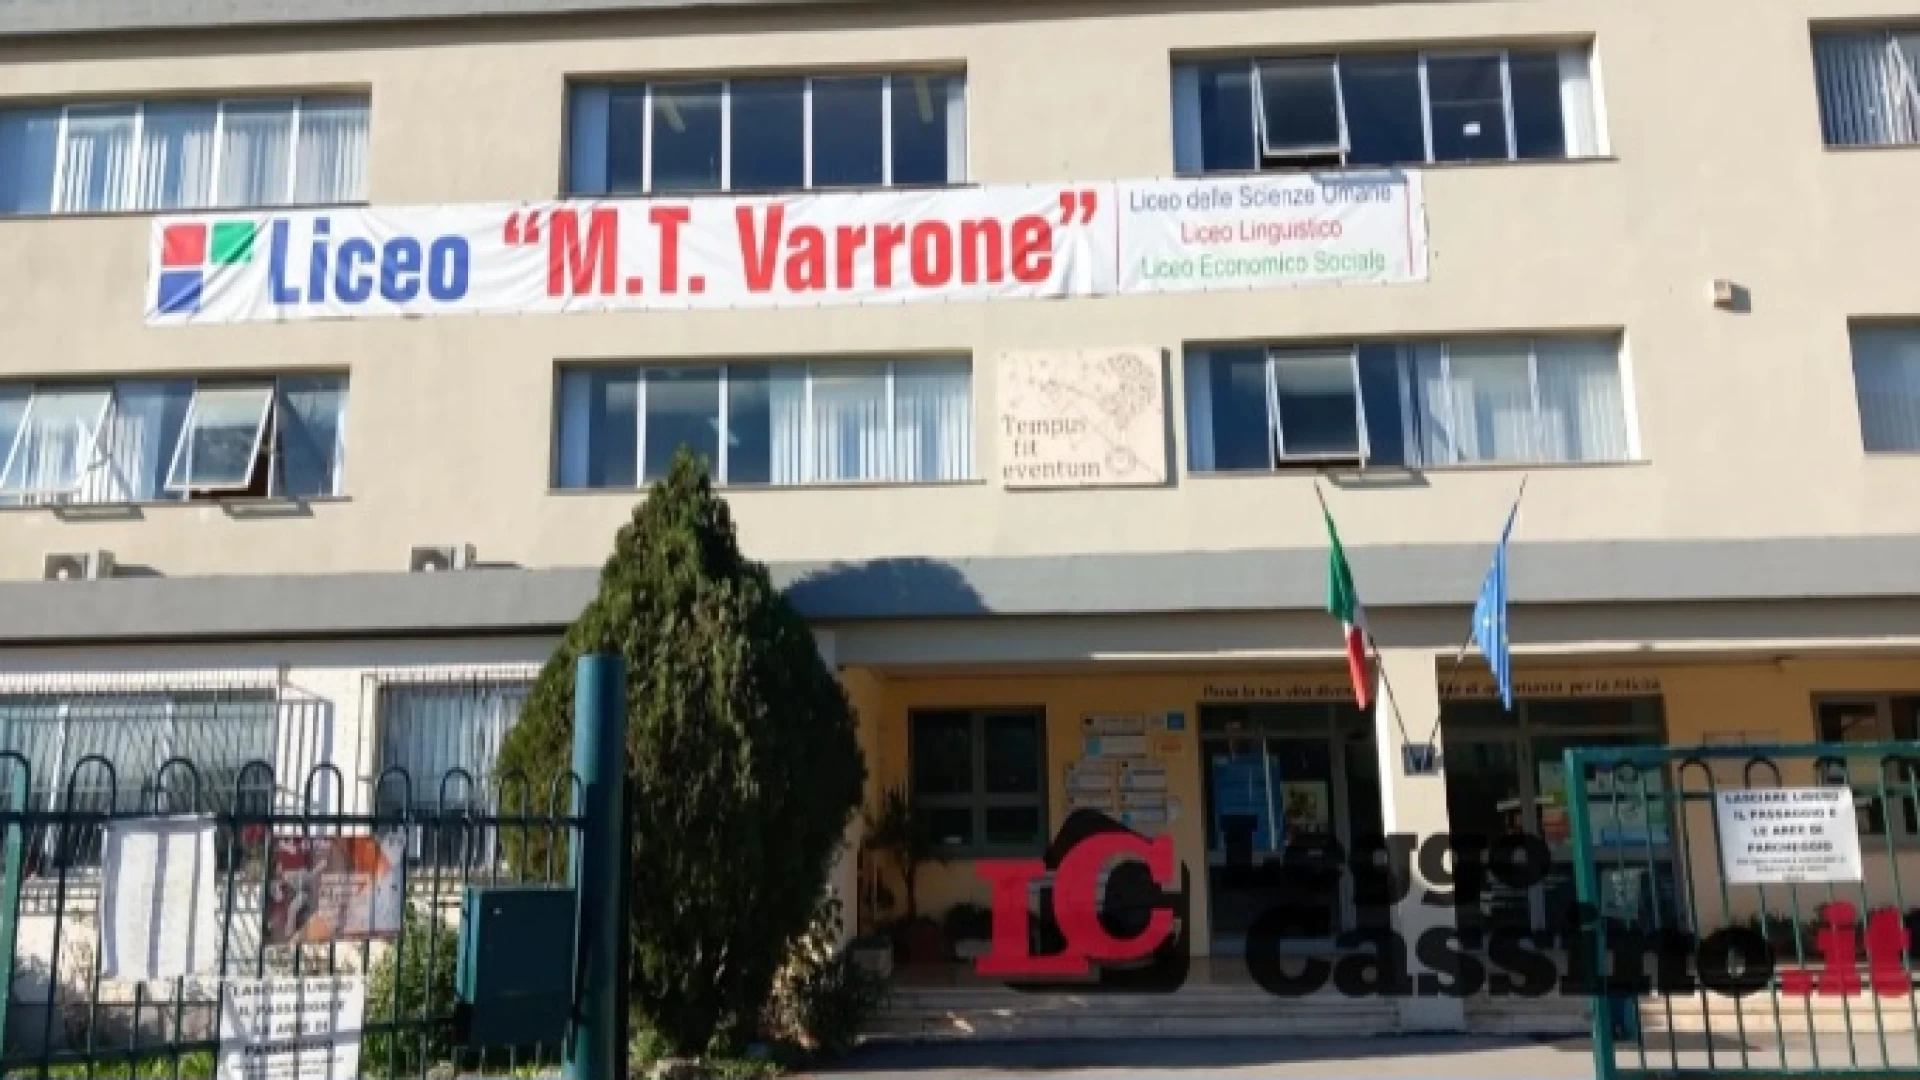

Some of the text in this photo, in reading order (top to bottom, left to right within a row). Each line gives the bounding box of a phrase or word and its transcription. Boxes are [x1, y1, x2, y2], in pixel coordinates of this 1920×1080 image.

[1130, 182, 1392, 212] Liceo delle Scienze Umane
[1180, 217, 1343, 246] Liceo Linguistico
[268, 218, 470, 304] Liceo
[1141, 248, 1386, 280] Liceo Economico Sociale
[1001, 414, 1087, 438] Tempus
[1002, 461, 1102, 480] eventum
